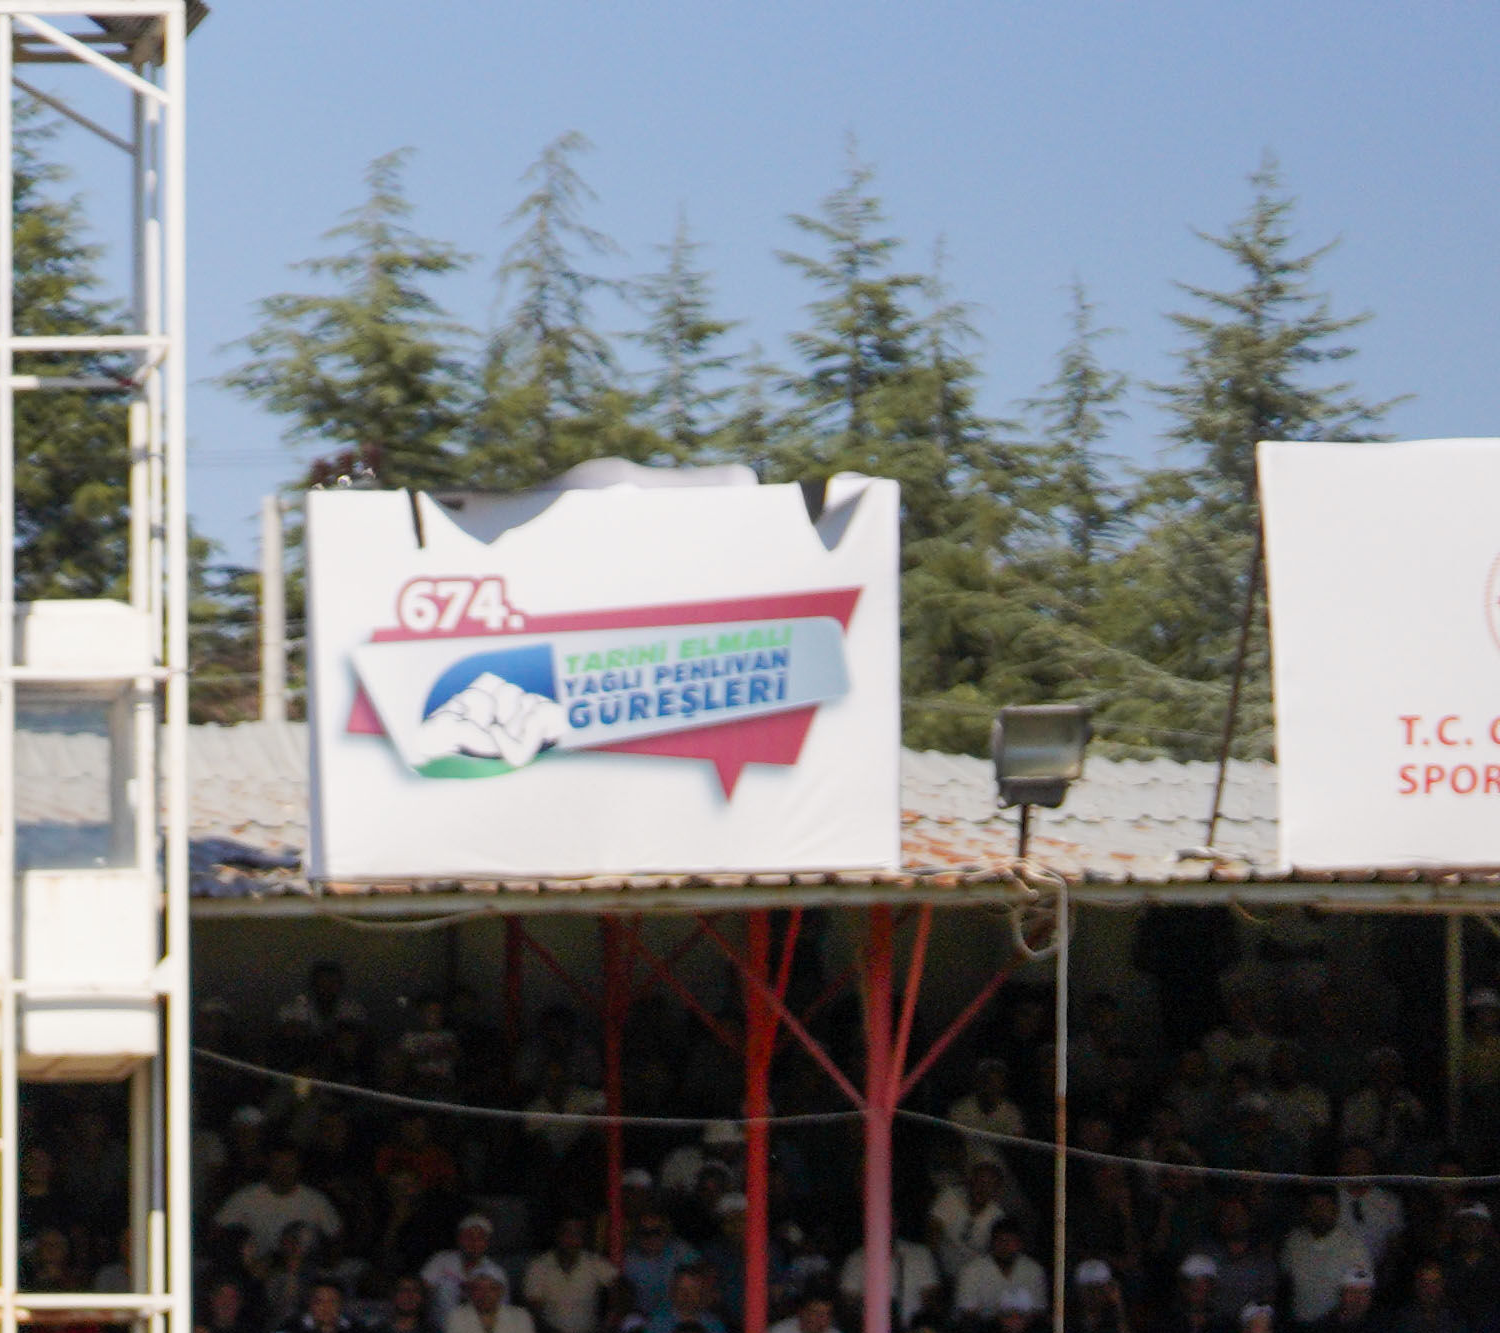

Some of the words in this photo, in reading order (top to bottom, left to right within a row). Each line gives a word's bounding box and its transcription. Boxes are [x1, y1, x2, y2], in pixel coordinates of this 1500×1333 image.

[399, 579, 524, 633] 674.
[567, 671, 789, 729] GÜREŞLERİ
[1398, 714, 1474, 746] T.C.
[1398, 763, 1500, 795] SPOR
